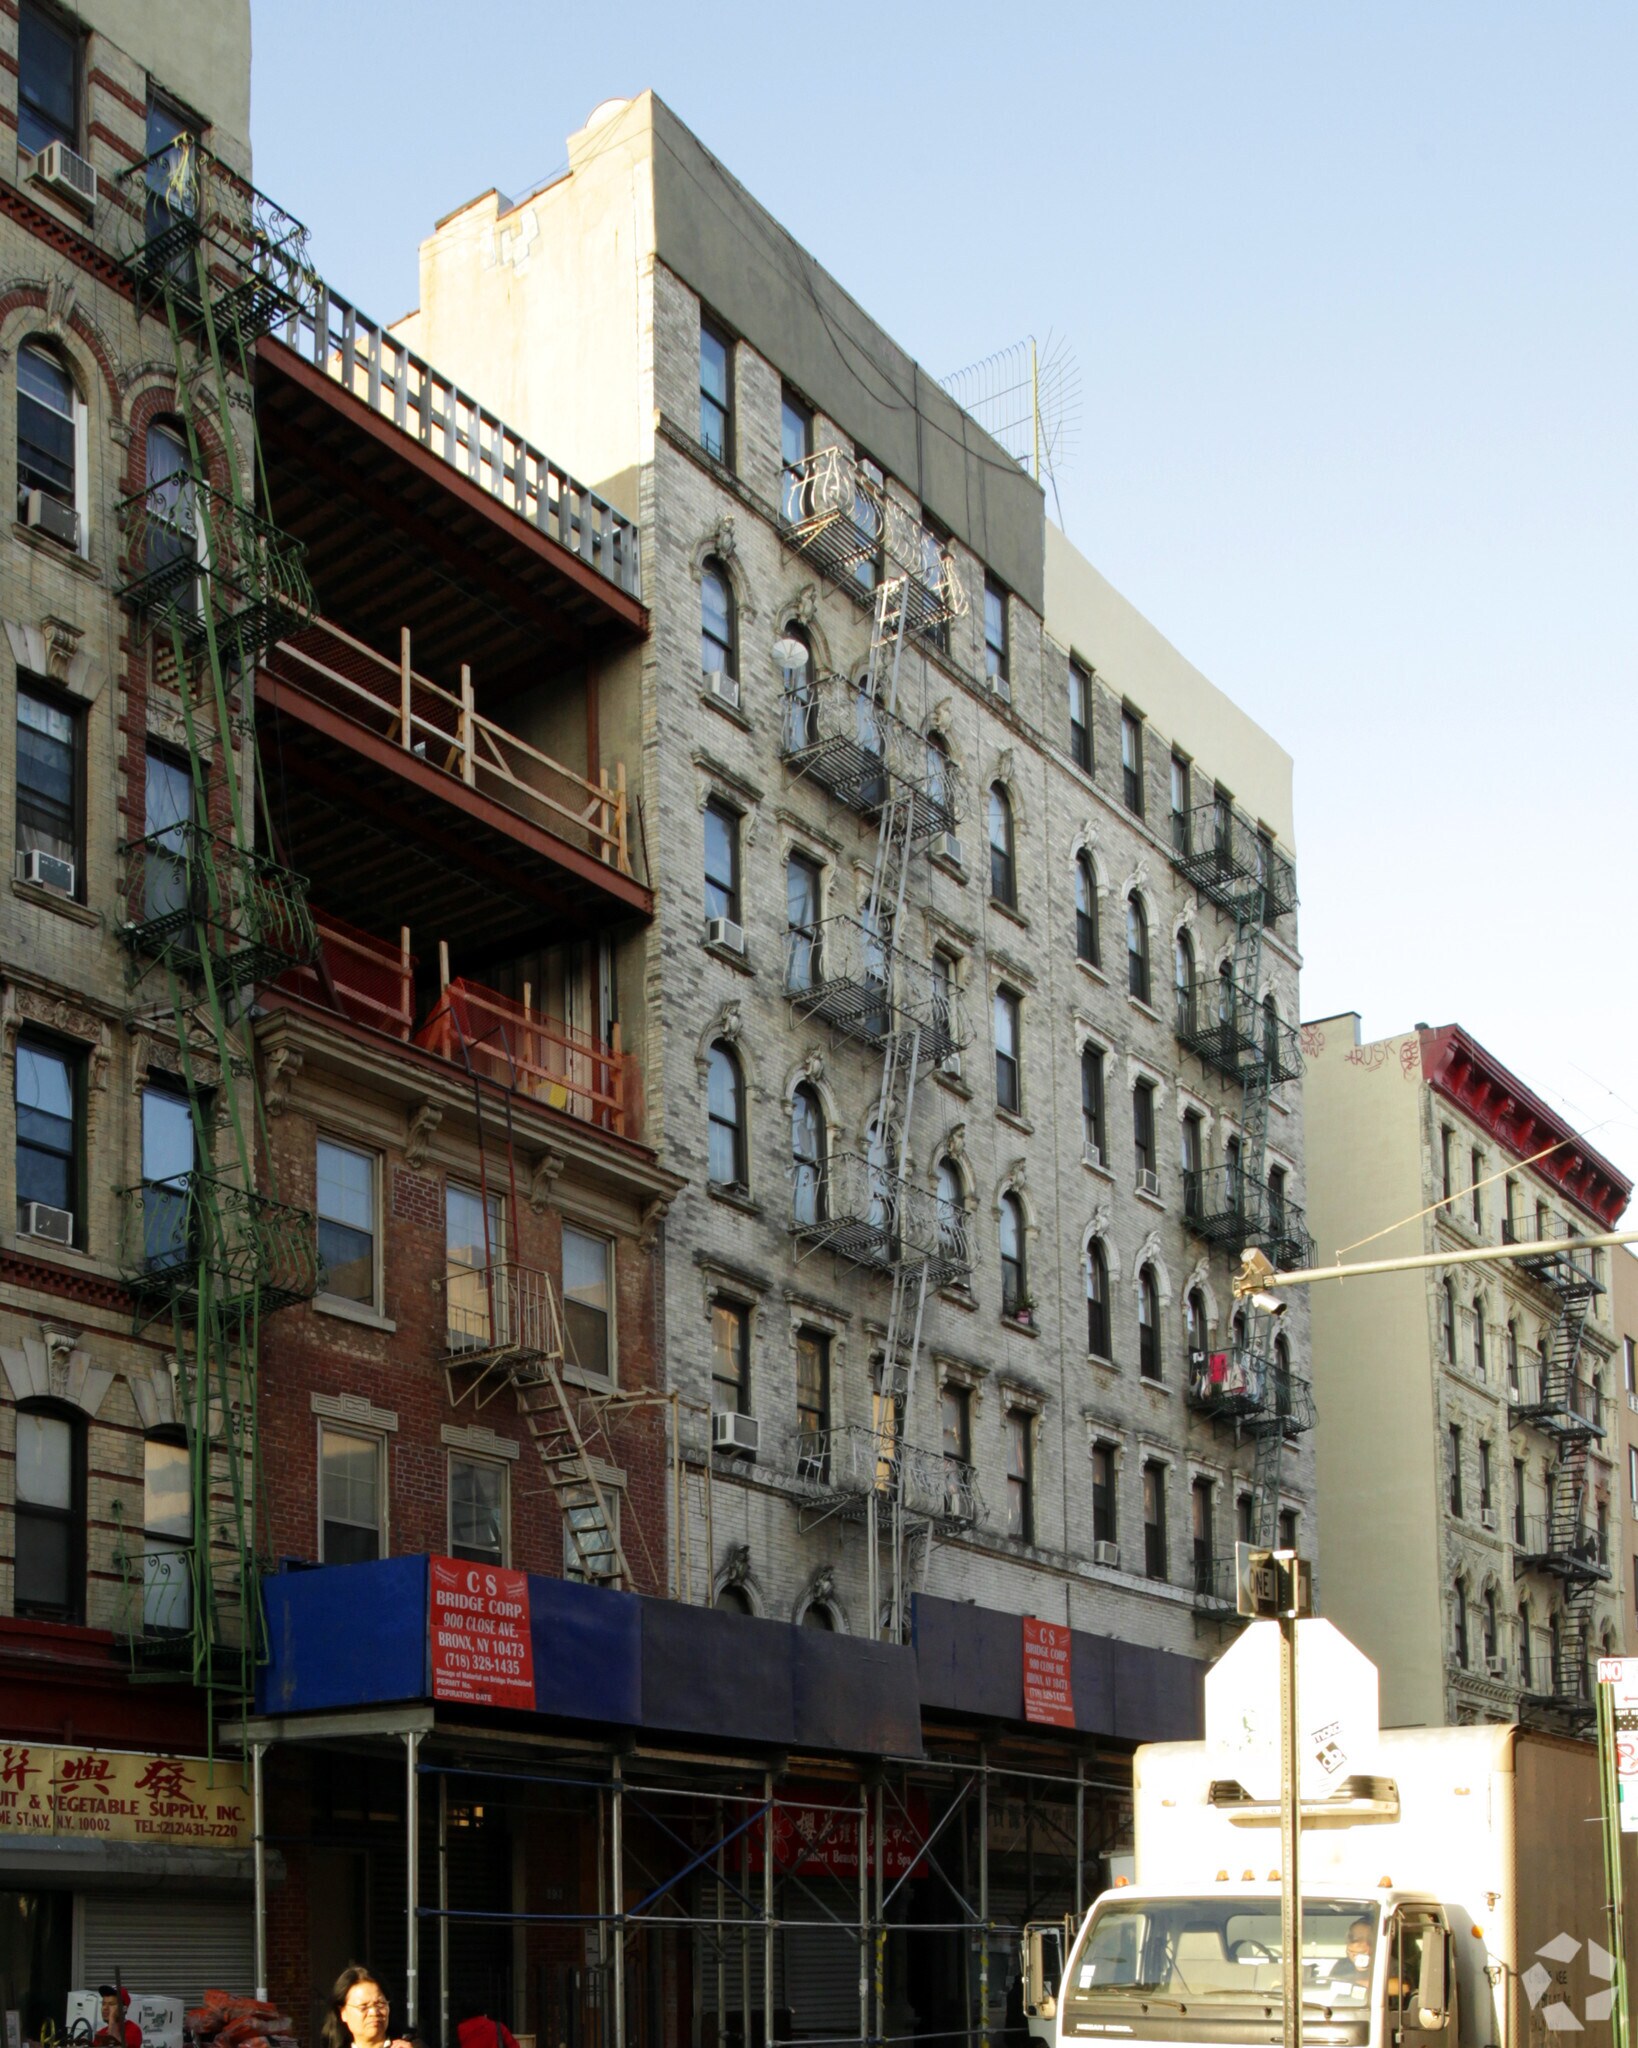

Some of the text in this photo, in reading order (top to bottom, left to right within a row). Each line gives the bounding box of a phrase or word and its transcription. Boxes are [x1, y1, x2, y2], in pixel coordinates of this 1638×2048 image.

[1249, 1568, 1269, 1597] ONE
[436, 1590, 526, 1620] BRIDGE CORP.
[443, 1612, 519, 1639] 900 CLOSE AVE.
[438, 1631, 525, 1658] BRONX, NY 10473
[445, 1652, 520, 1675] (718) 328-1435
[1601, 1662, 1622, 1681] NO
[436, 1677, 460, 1688] PERMIT
[437, 1688, 492, 1702] EXPIRATION DATE
[29, 1794, 41, 1810] &
[46, 1795, 140, 1816] VEGETABLE
[149, 1801, 208, 1821] SUPPLY,
[216, 1805, 246, 1822] INC.
[56, 1815, 75, 1829] N.Y.
[79, 1817, 110, 1832] 10002
